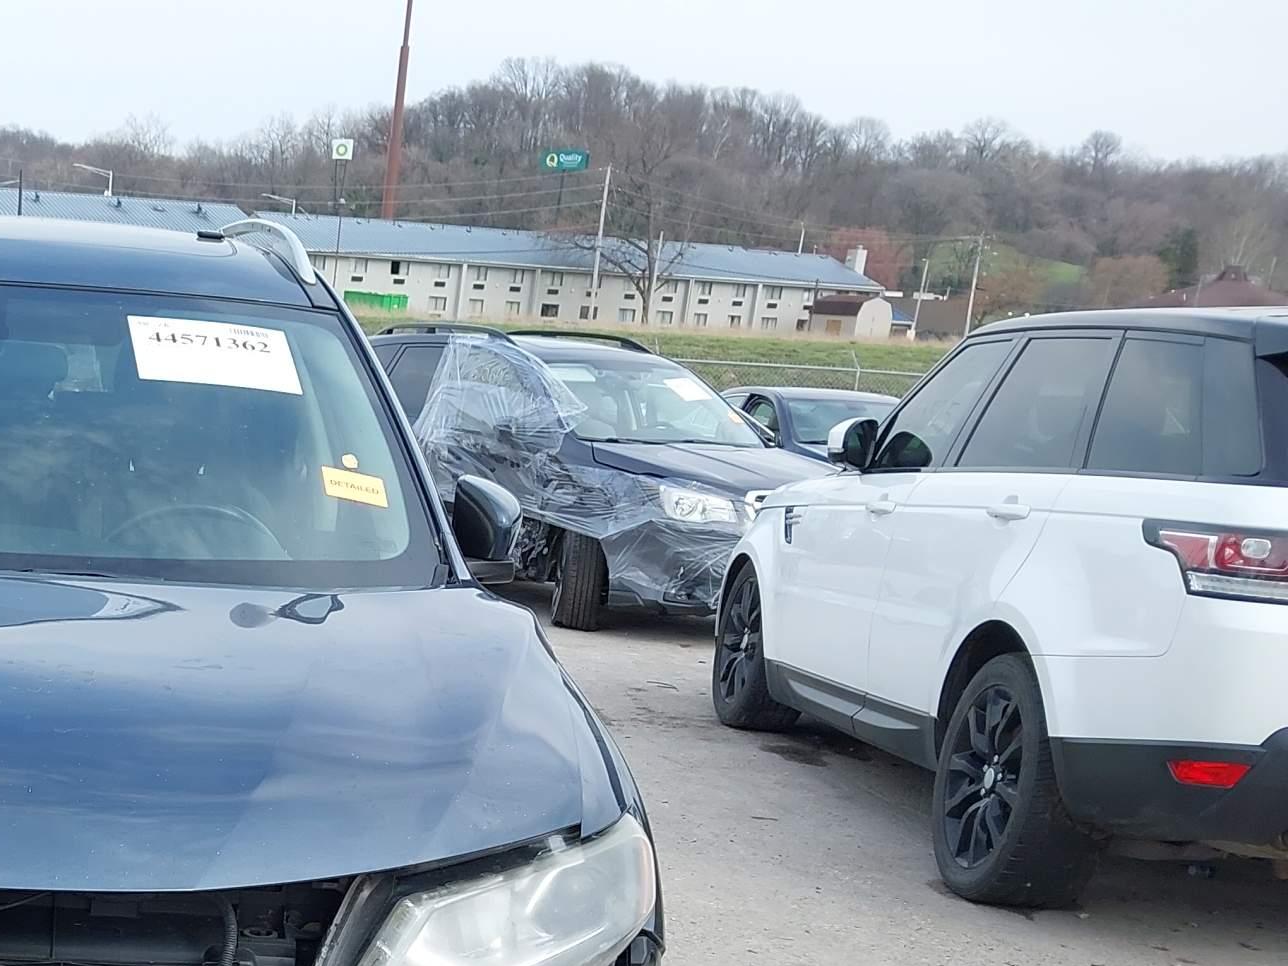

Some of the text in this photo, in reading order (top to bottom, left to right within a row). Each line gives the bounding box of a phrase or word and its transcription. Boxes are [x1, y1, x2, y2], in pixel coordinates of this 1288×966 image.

[559, 153, 582, 162] Quality
[148, 332, 271, 353] 44571362
[329, 479, 380, 495] DETAILED
